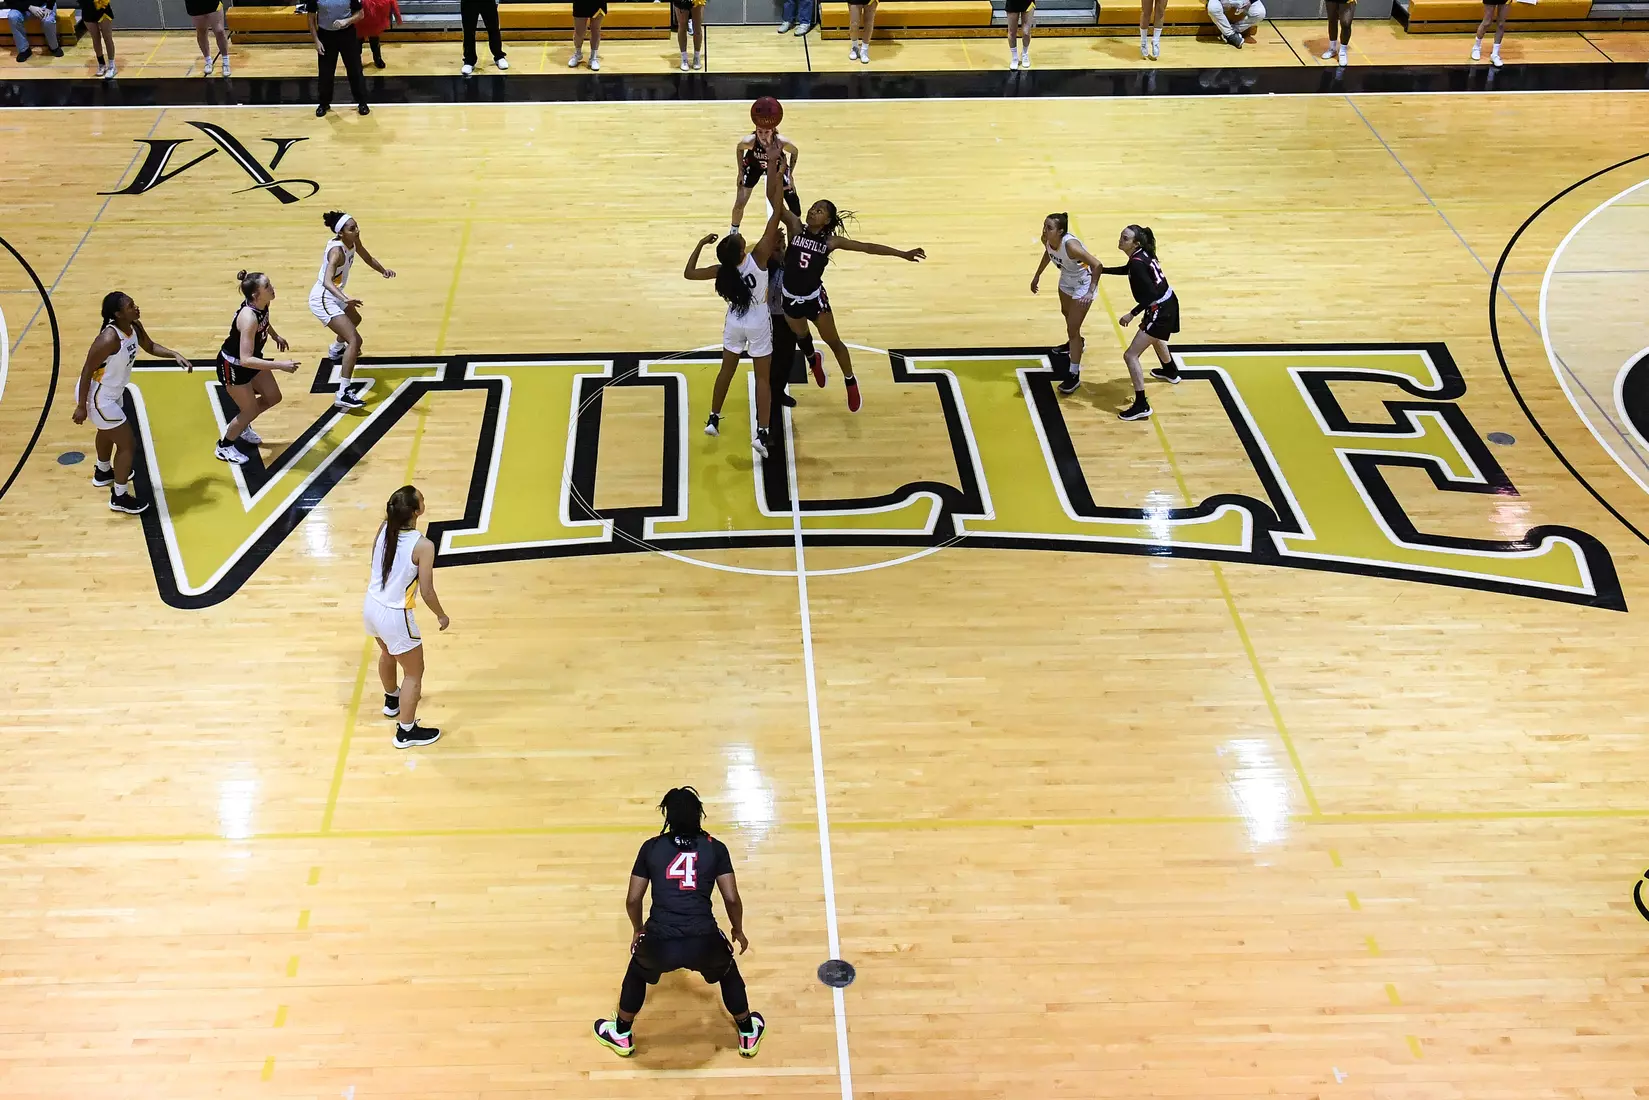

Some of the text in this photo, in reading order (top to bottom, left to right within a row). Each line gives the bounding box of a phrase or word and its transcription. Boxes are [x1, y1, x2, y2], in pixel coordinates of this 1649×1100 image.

[799, 251, 812, 269] 5
[120, 341, 1628, 612] VILLE
[666, 851, 698, 891] 4
